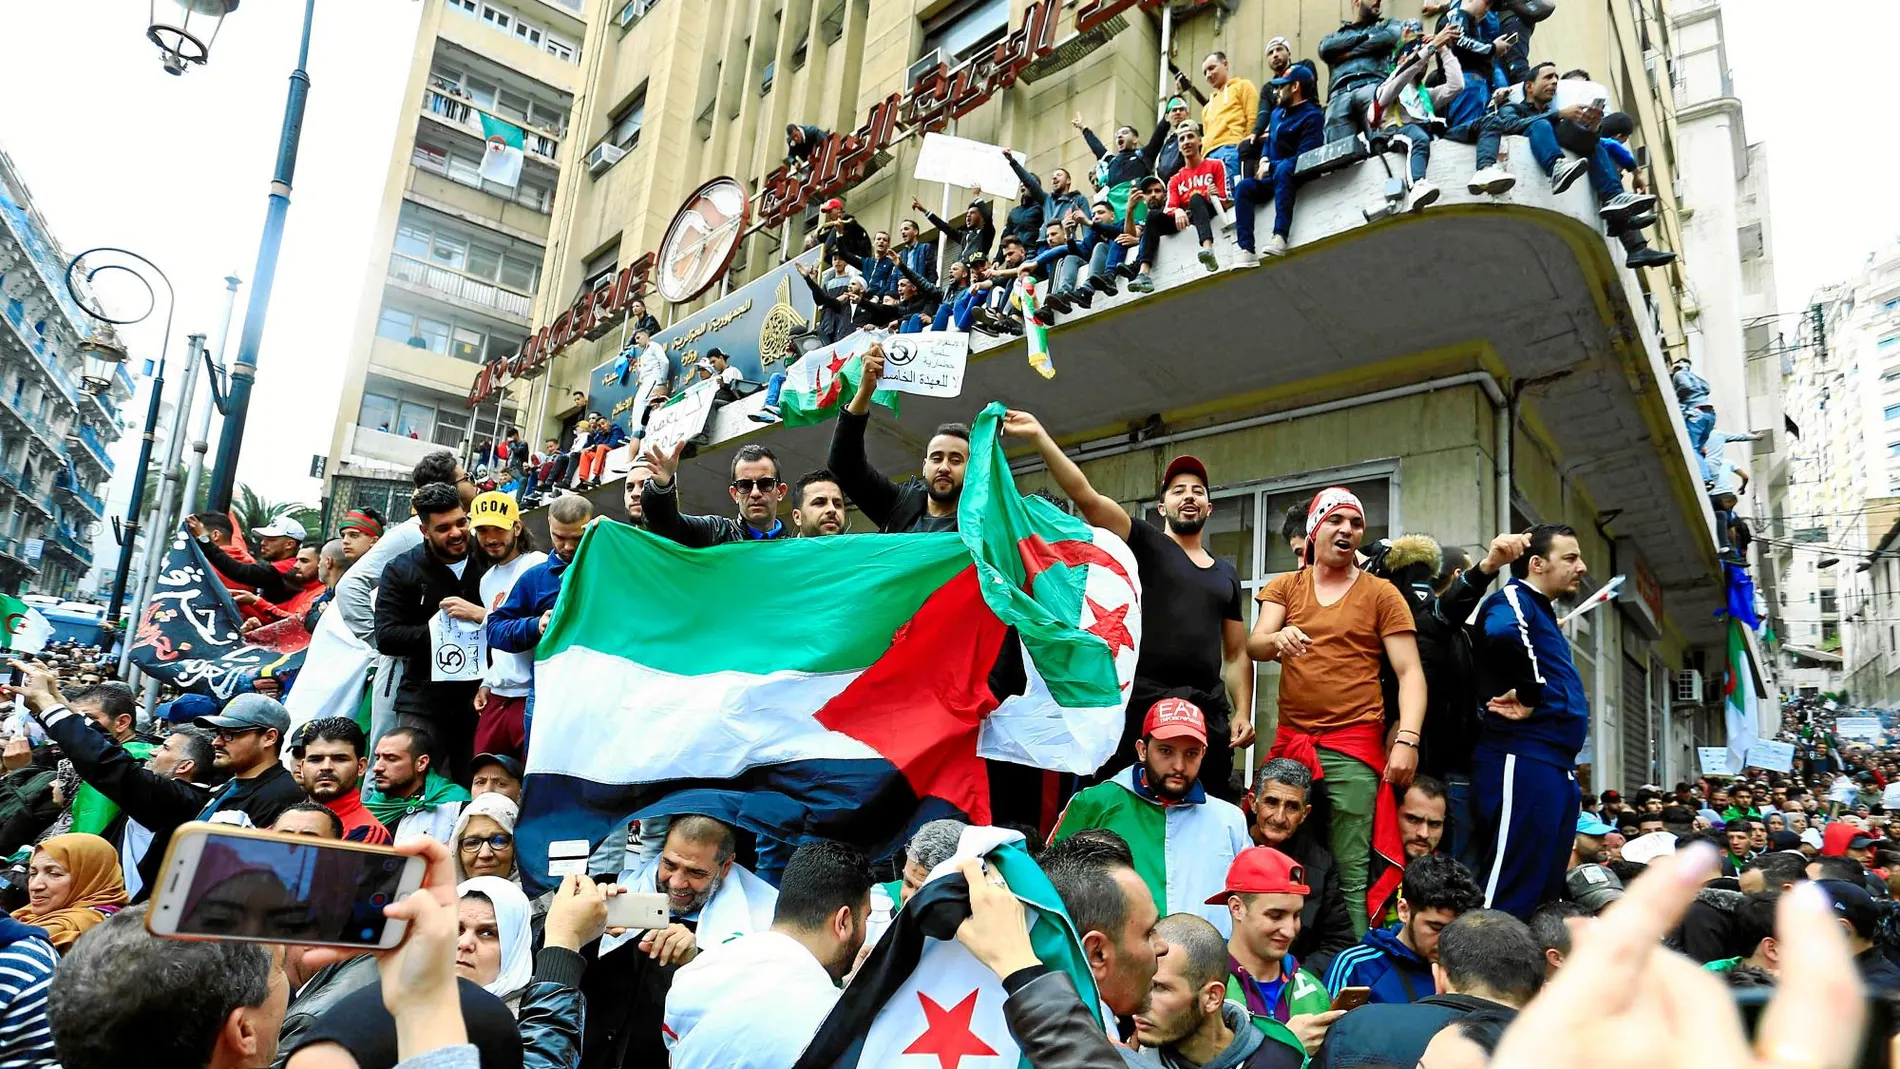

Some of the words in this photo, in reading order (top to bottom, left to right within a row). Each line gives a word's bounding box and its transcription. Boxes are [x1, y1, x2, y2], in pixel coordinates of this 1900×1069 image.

[1177, 173, 1214, 195] KING
[466, 355, 512, 409] AIR
[882, 369, 916, 384] الخامس
[920, 373, 949, 390] للعهدة
[475, 500, 509, 516] ICON
